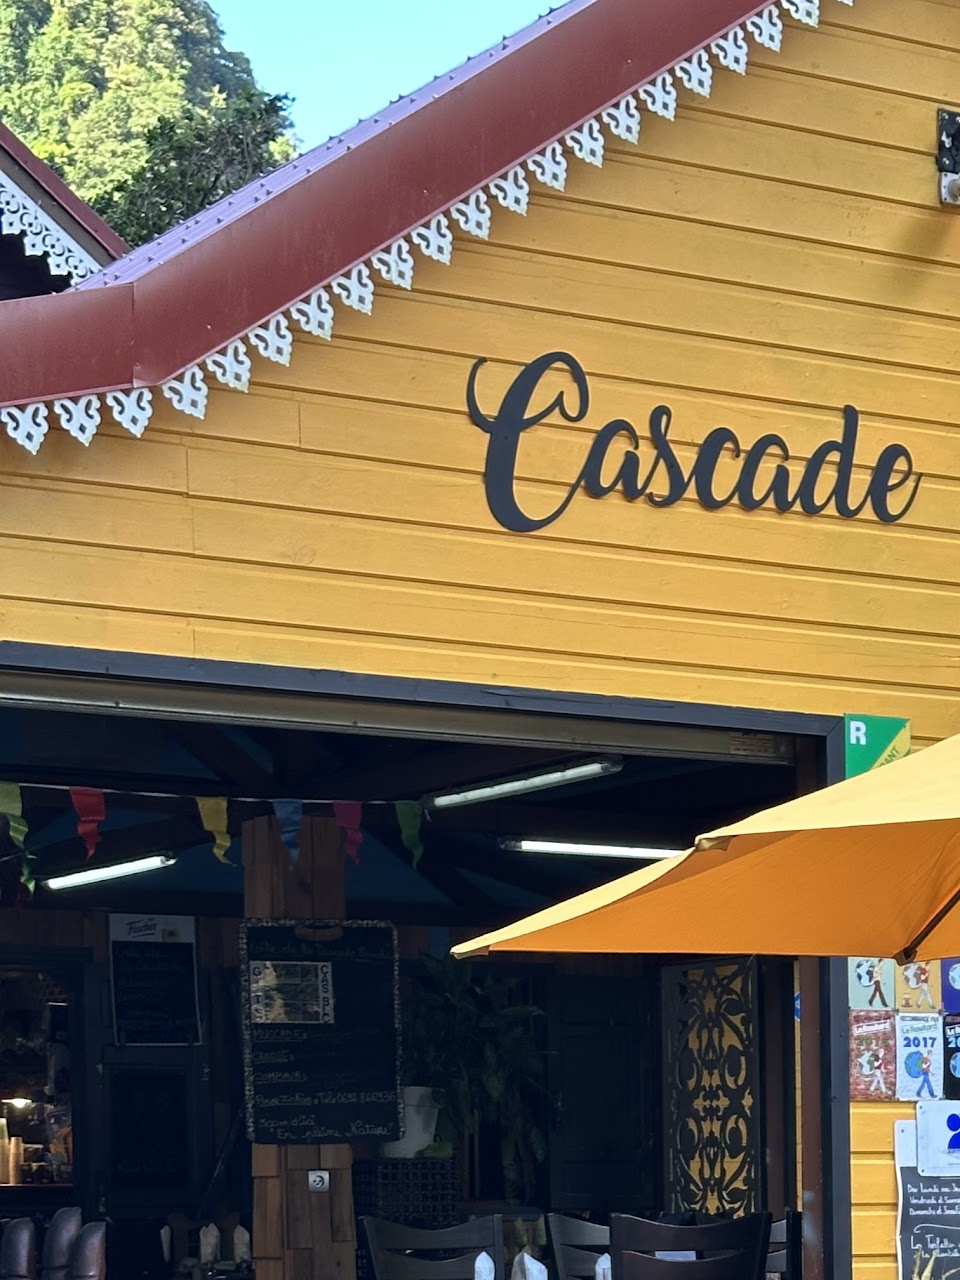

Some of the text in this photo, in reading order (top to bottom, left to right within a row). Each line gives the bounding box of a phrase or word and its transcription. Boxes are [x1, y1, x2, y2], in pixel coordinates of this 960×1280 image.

[467, 351, 923, 534] Cascade
[850, 720, 867, 745] R
[903, 1036, 937, 1048] 2017
